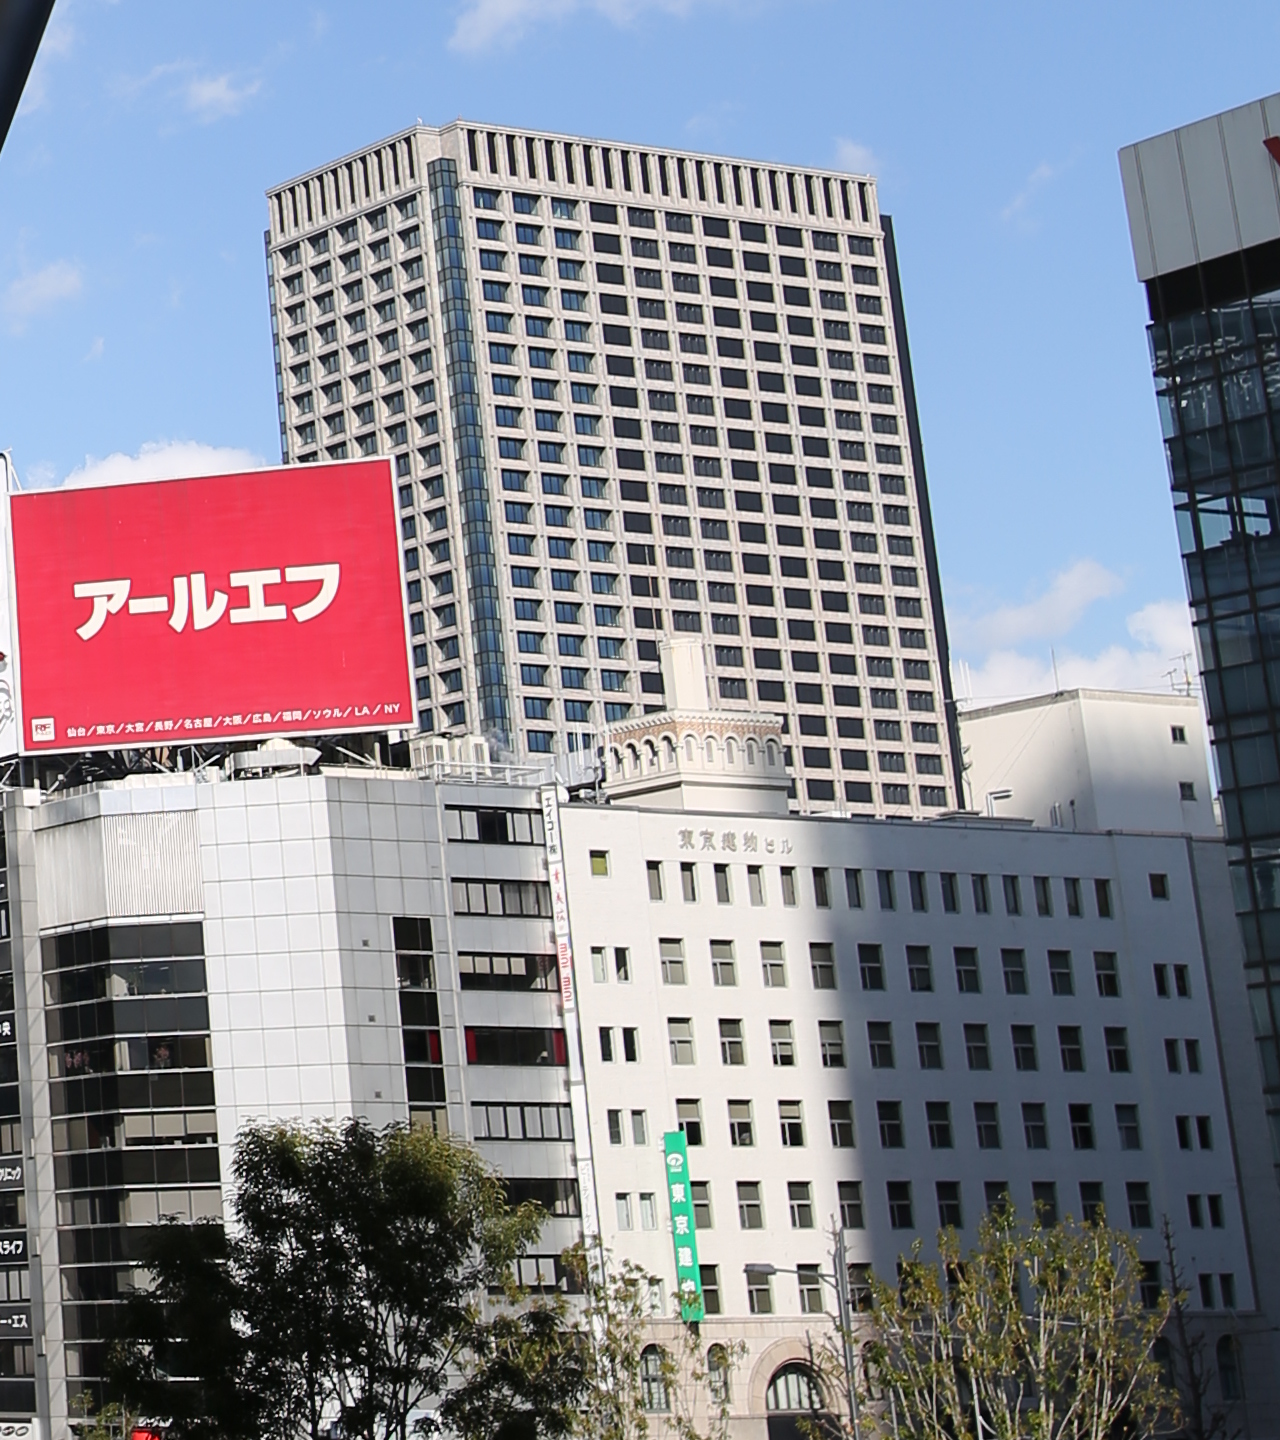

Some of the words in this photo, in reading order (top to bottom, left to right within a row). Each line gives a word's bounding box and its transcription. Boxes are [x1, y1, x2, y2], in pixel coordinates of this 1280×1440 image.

[73, 562, 340, 642] アールエフ
[678, 828, 793, 855] 東京建物ビル
